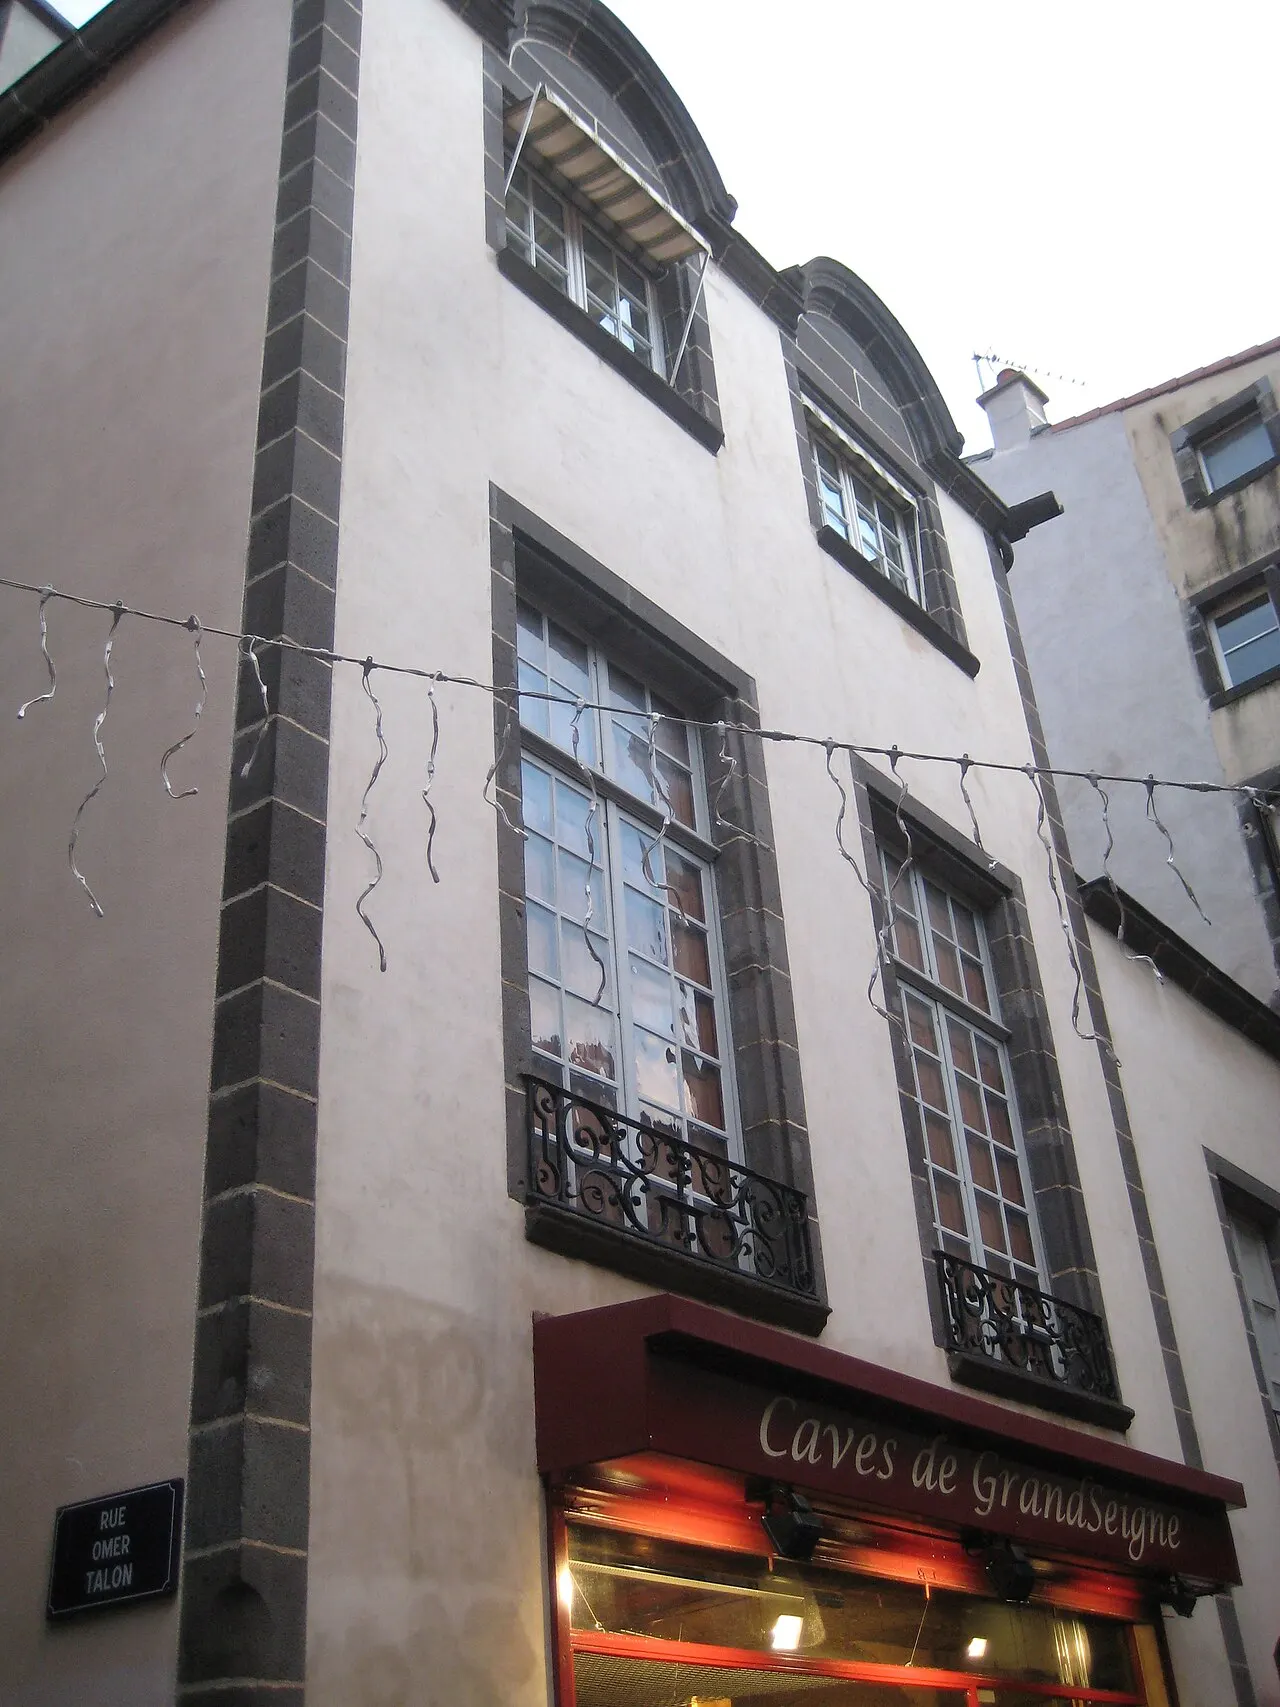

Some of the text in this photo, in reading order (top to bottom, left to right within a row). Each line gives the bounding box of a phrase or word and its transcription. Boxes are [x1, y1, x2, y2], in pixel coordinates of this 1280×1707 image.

[759, 1397, 1181, 1561] Caves de GrandSeigne
[100, 1506, 127, 1530] RUE
[92, 1535, 131, 1561] OMER
[86, 1562, 133, 1593] TALON
